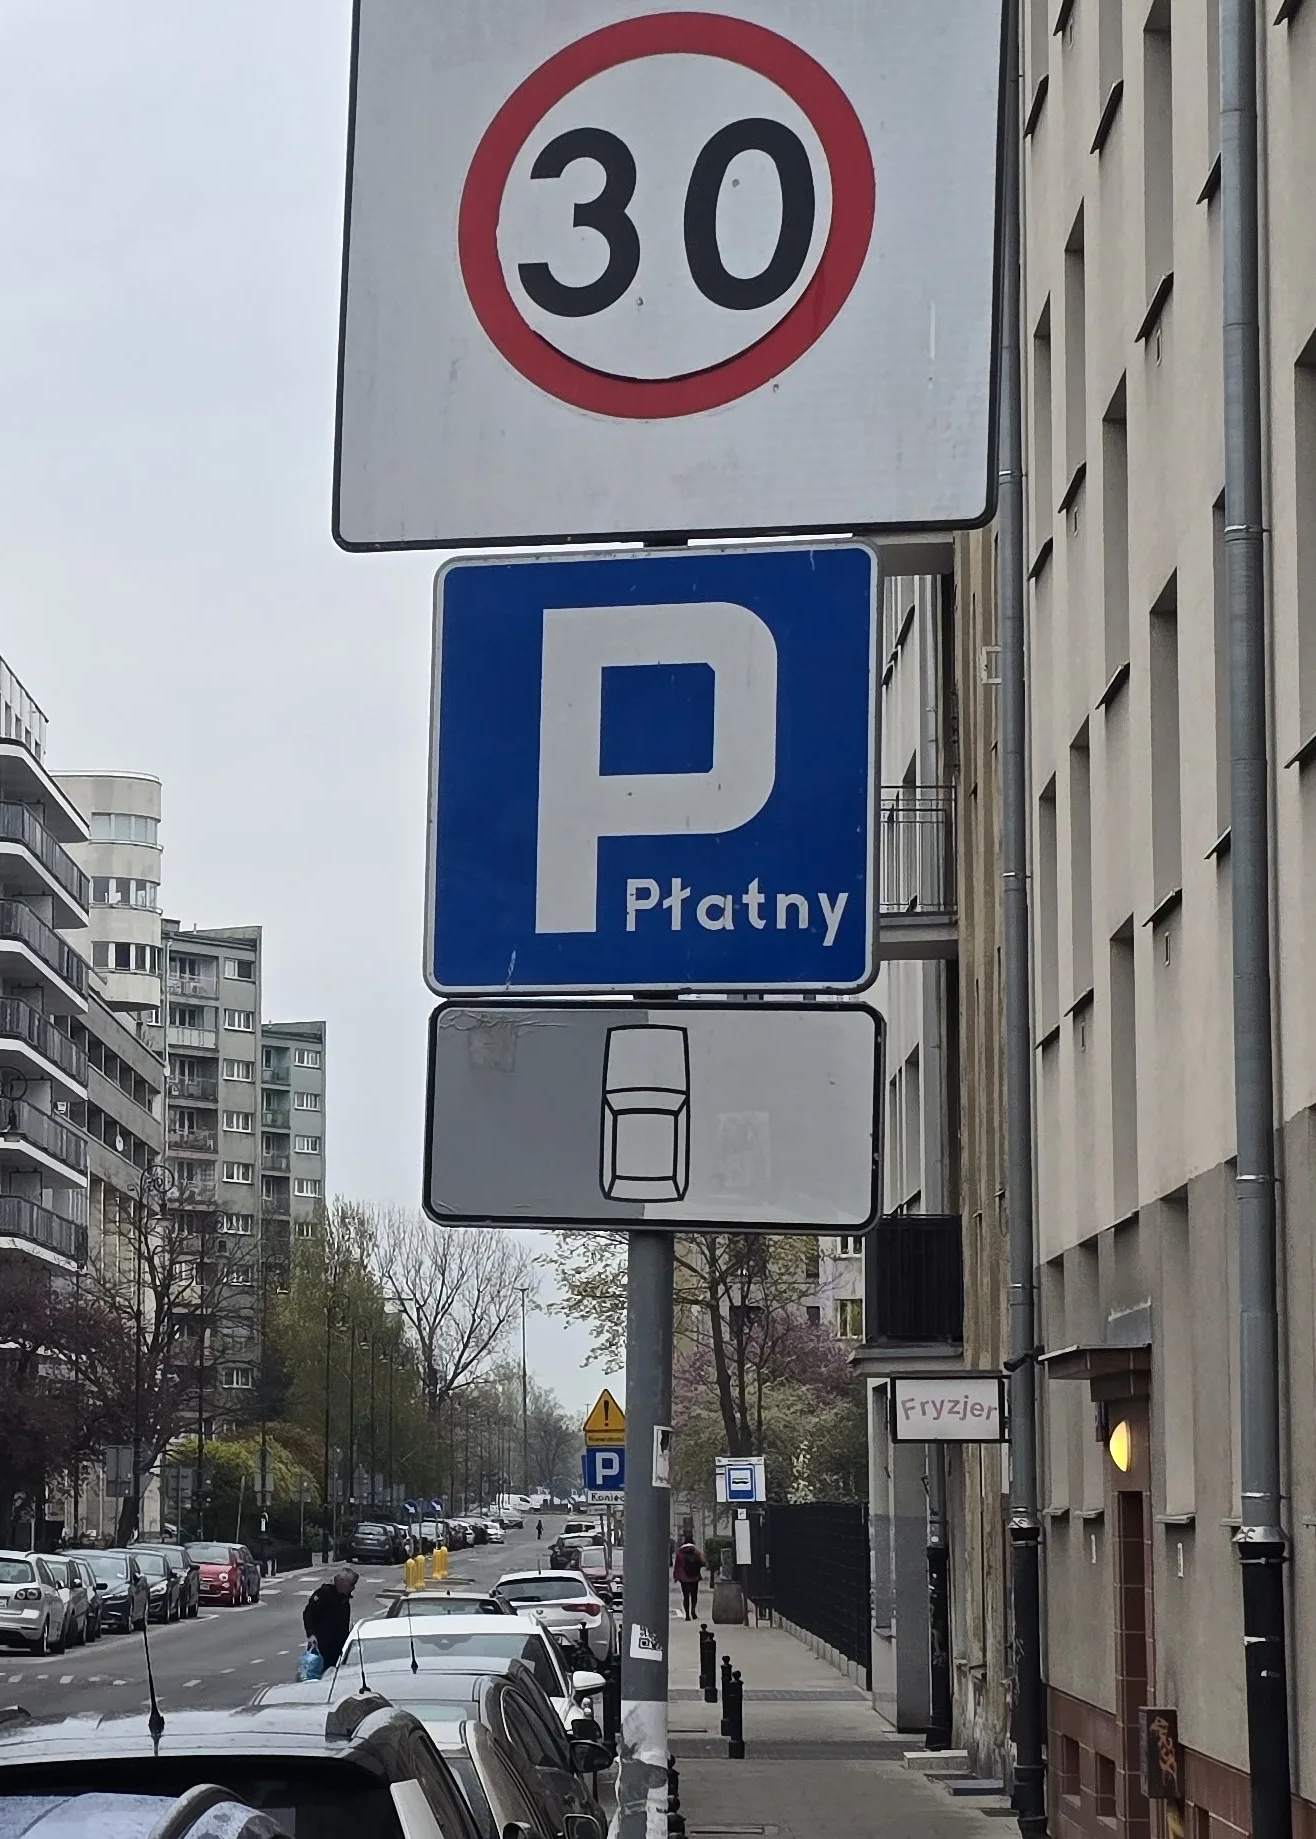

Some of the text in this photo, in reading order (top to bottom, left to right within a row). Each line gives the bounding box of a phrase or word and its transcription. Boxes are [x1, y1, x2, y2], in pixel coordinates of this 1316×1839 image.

[518, 118, 815, 318] 30
[536, 602, 778, 934] P
[626, 877, 848, 947] Płatny
[901, 1395, 998, 1422] Fryzjer
[596, 1452, 620, 1485] P
